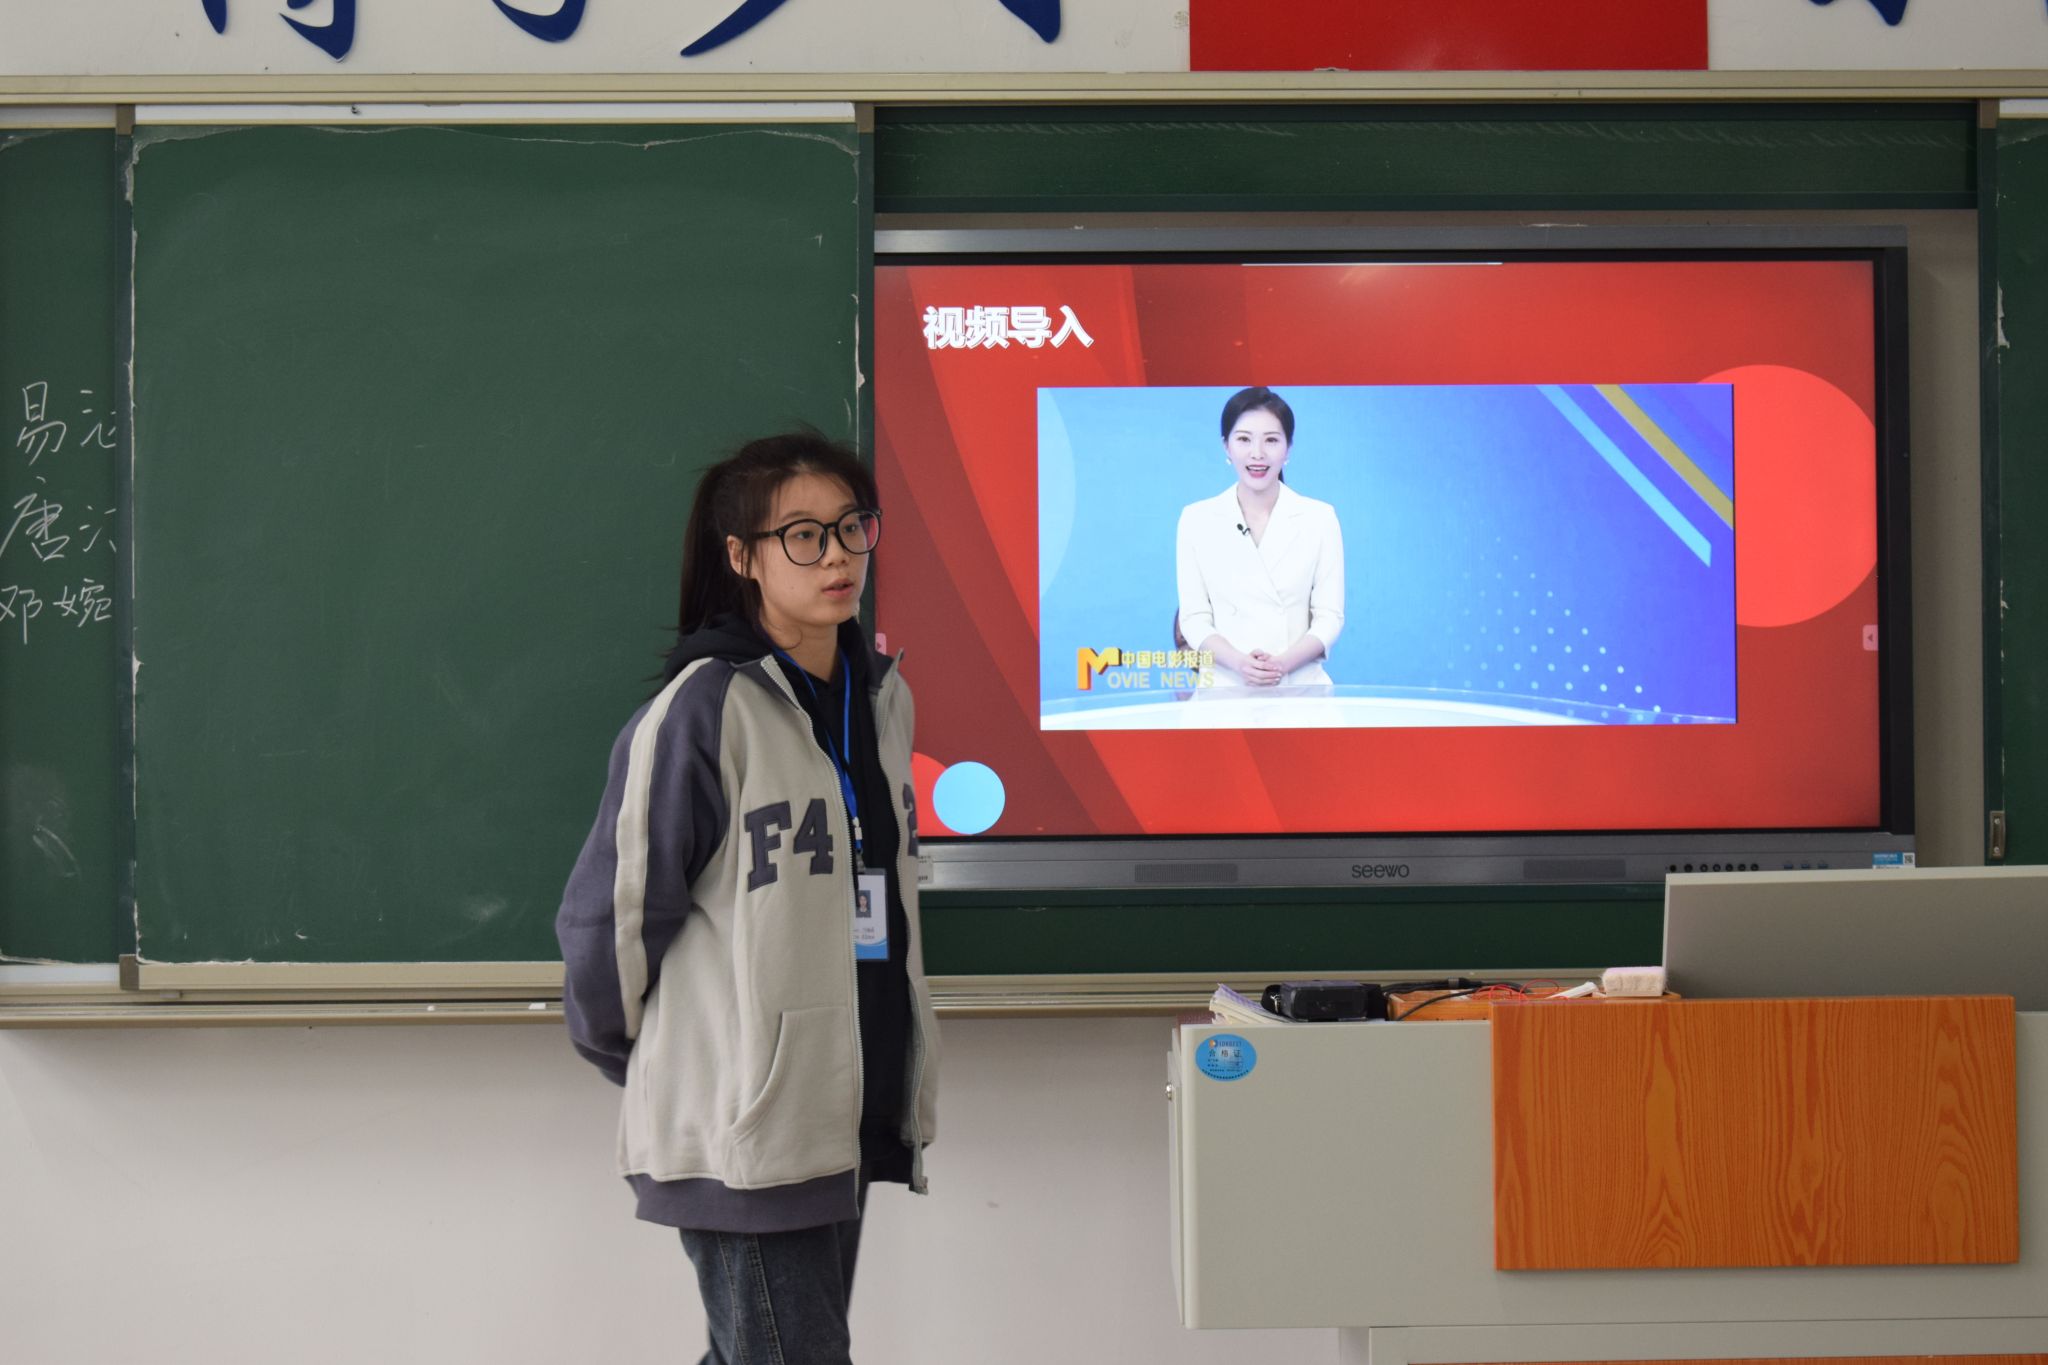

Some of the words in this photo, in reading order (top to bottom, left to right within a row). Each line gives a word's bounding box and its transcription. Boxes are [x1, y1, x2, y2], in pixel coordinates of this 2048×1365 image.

[923, 305, 1094, 350] 视频导入
[1121, 650, 1216, 670] 中国电影报道
[1161, 672, 1215, 689] NEWS
[744, 798, 834, 893] F4
[1351, 864, 1410, 879] seewo
